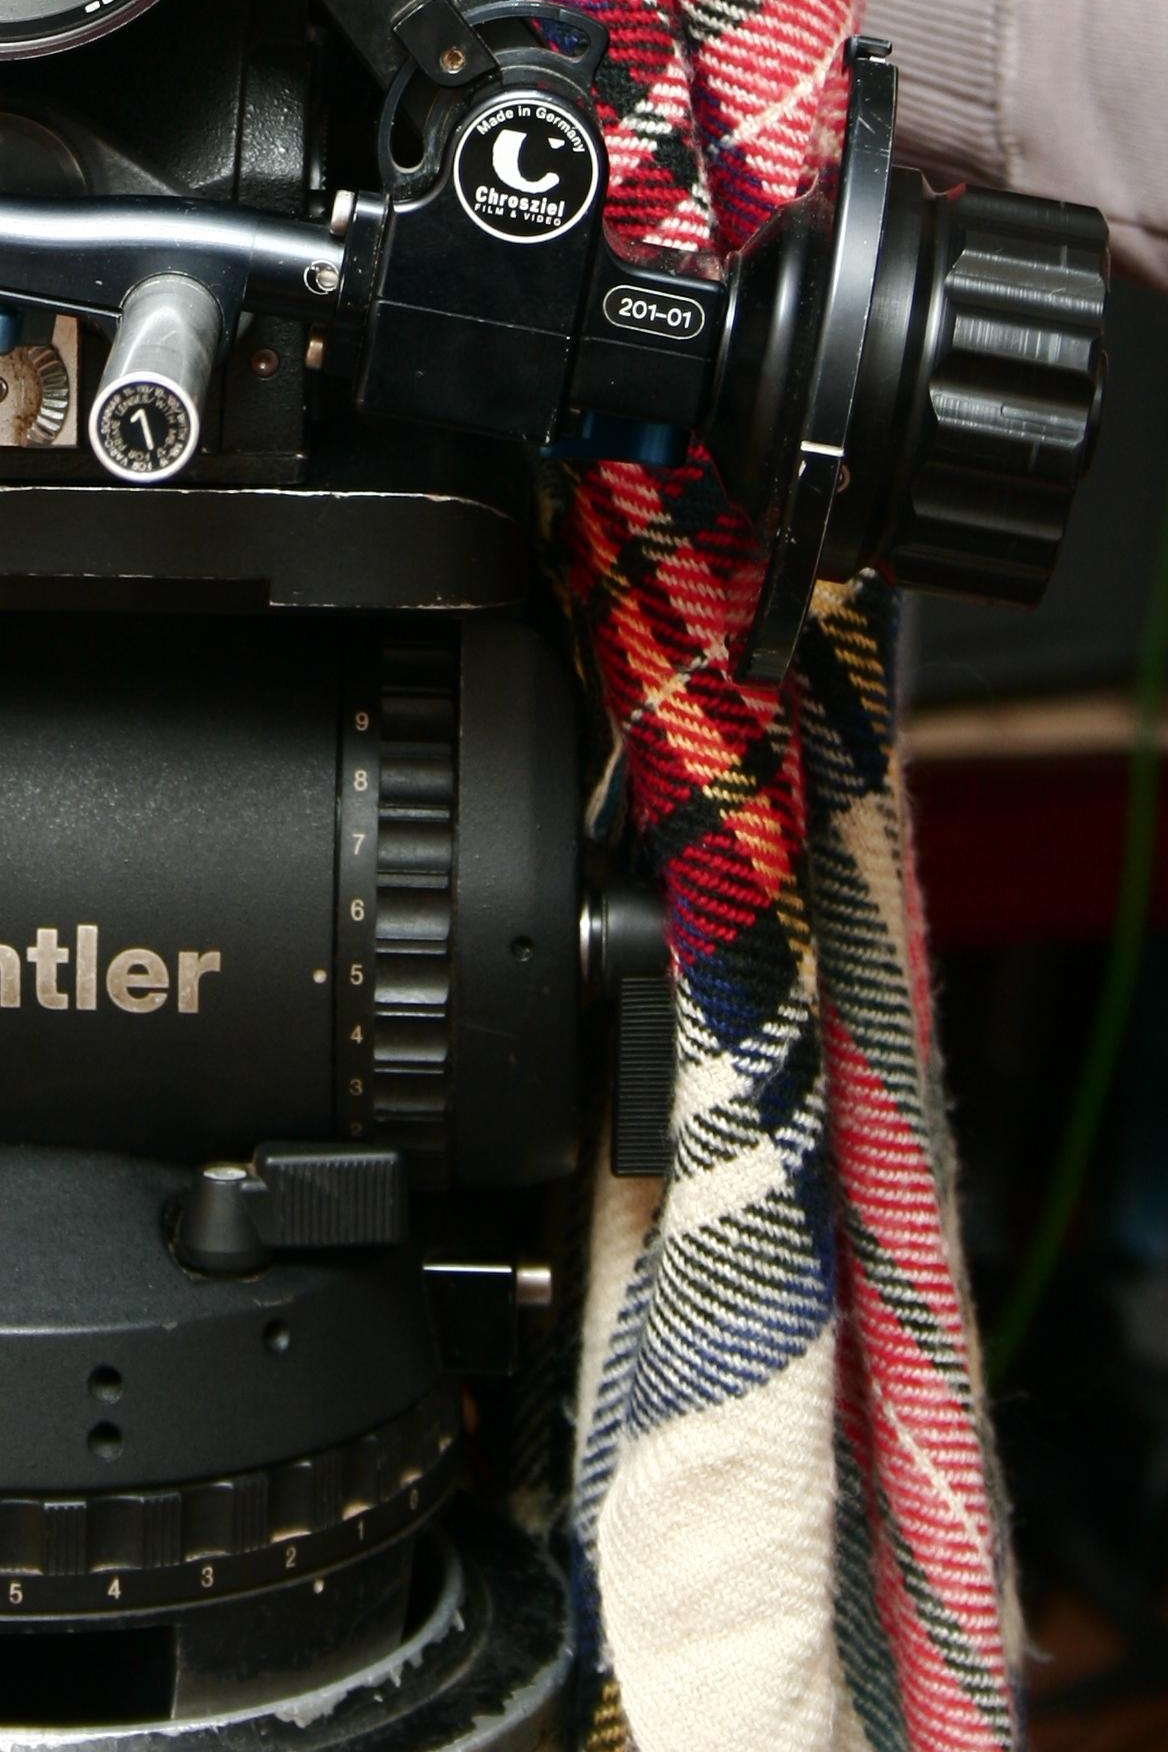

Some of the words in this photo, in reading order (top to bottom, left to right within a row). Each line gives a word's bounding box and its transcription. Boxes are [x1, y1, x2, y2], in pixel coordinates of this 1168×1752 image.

[476, 108, 515, 136] Made
[517, 105, 531, 117] in
[535, 106, 586, 153] Germany
[474, 185, 566, 217] Chrosziel
[474, 203, 505, 216] FILM
[509, 209, 517, 219] &
[523, 212, 562, 227] VIDEO
[618, 297, 693, 329] 201-01
[355, 711, 370, 732] 9
[353, 769, 369, 792] 8
[351, 832, 366, 855] 7
[350, 899, 365, 921] 6
[350, 963, 364, 986] 5
[350, 1025, 363, 1044] 4
[350, 1078, 364, 1096] 3
[9, 1582, 23, 1604] 5
[107, 1578, 121, 1599] 4
[201, 1565, 214, 1588] 3
[285, 1547, 297, 1568] 2
[409, 1489, 418, 1509] 0
